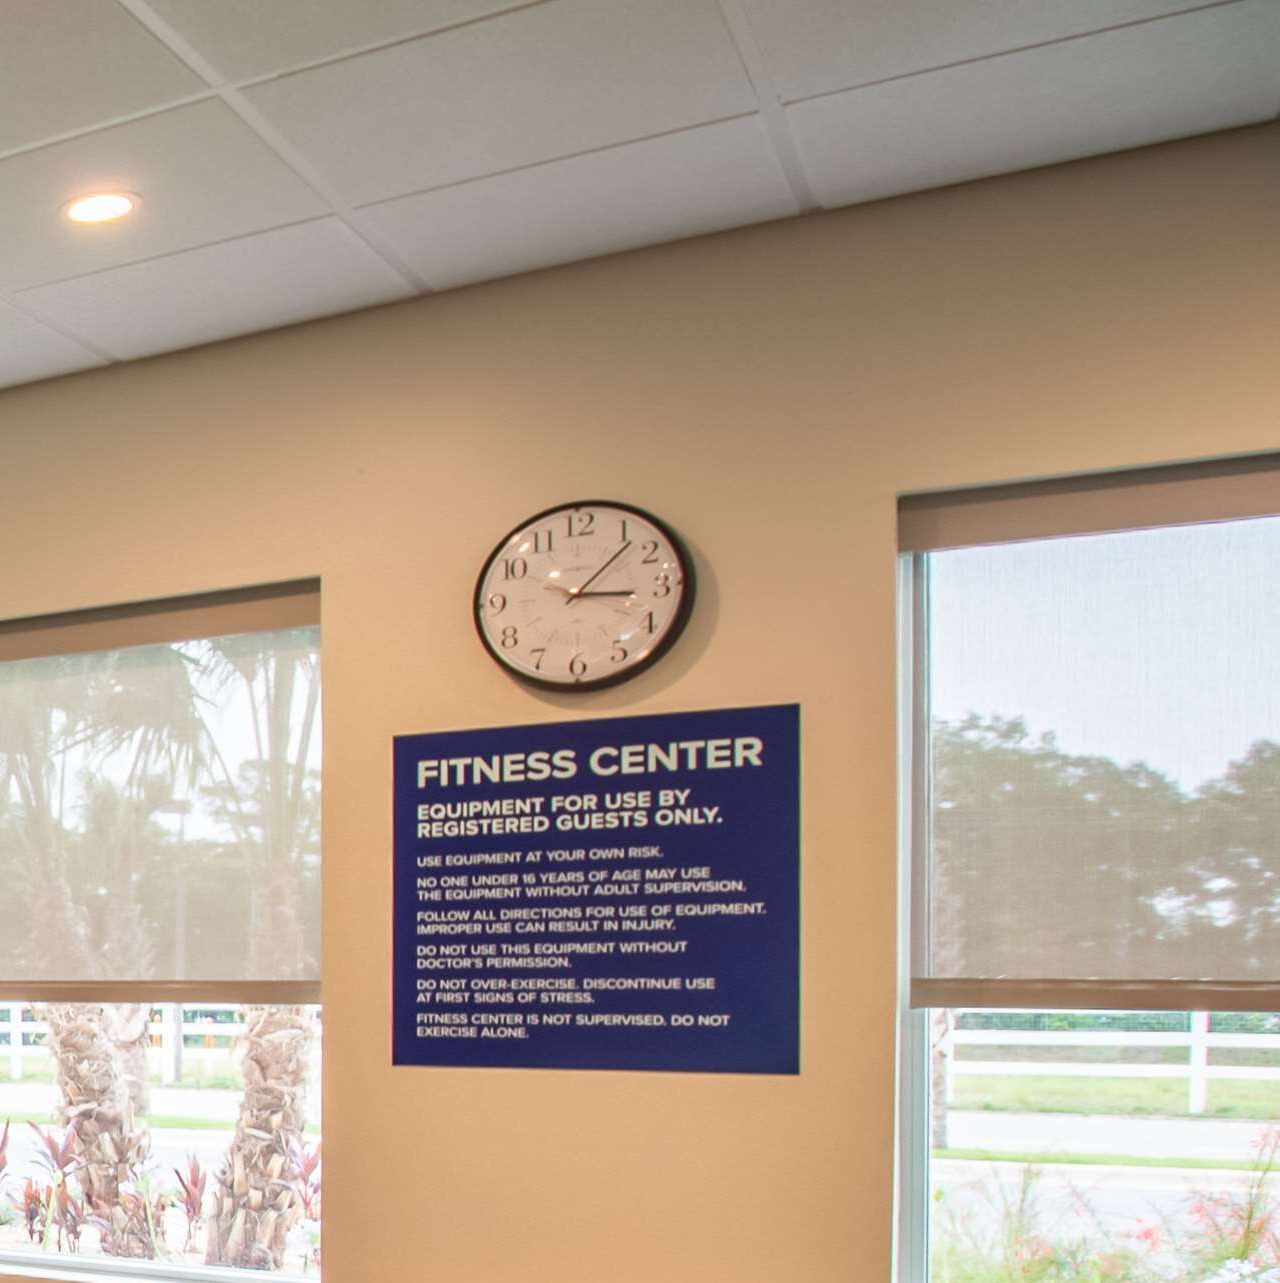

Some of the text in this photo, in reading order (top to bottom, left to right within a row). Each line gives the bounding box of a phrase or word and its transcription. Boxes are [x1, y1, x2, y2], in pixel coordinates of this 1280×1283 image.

[564, 513, 595, 538] 12
[620, 519, 629, 542] 1
[532, 530, 553, 553] 11
[642, 540, 659, 564] 2
[502, 558, 527, 580] 10
[653, 574, 670, 598] 3
[489, 593, 507, 616] 9
[641, 611, 658, 634] 4
[501, 625, 518, 649] 8
[530, 648, 545, 671] 7
[610, 640, 628, 663] 5
[569, 653, 587, 677] 6
[417, 736, 764, 789] FITNESS CENTER
[417, 788, 691, 820] EQUIPMENT FOR USE BY
[417, 806, 723, 838] REGISTERED GUESTS ONLY.
[417, 846, 664, 867] USE EQUIPMENT AT YOUR OWN RISK.
[417, 866, 711, 888] NO ONE UNDER 16 YEARS OF AGE MAY USE
[417, 881, 747, 901] THE EQUIPMENT WITHOUT ADULT SUPERVISION.
[417, 902, 767, 922] FOLLOW ALL DIRECTIONS FOR USE OF EQUIPMENT.
[417, 918, 677, 935] IMPROPER USE CAN RESULT IN INJURY.
[416, 941, 688, 956] DO NOT USE THIS EQUIPMENT WITHOUT
[416, 956, 572, 969] DOCTOR'S PERMISSION.
[416, 977, 716, 990] DO NOT OVER-EXERCISE. DISCONTINUE USE
[416, 992, 595, 1003] AT FIRST SIGNS OF STRESS.
[416, 1013, 730, 1027] FITNESS CENTER IS NOT SUPERVISED. DO NOT
[416, 1026, 529, 1038] EXERCISE ALONE.
